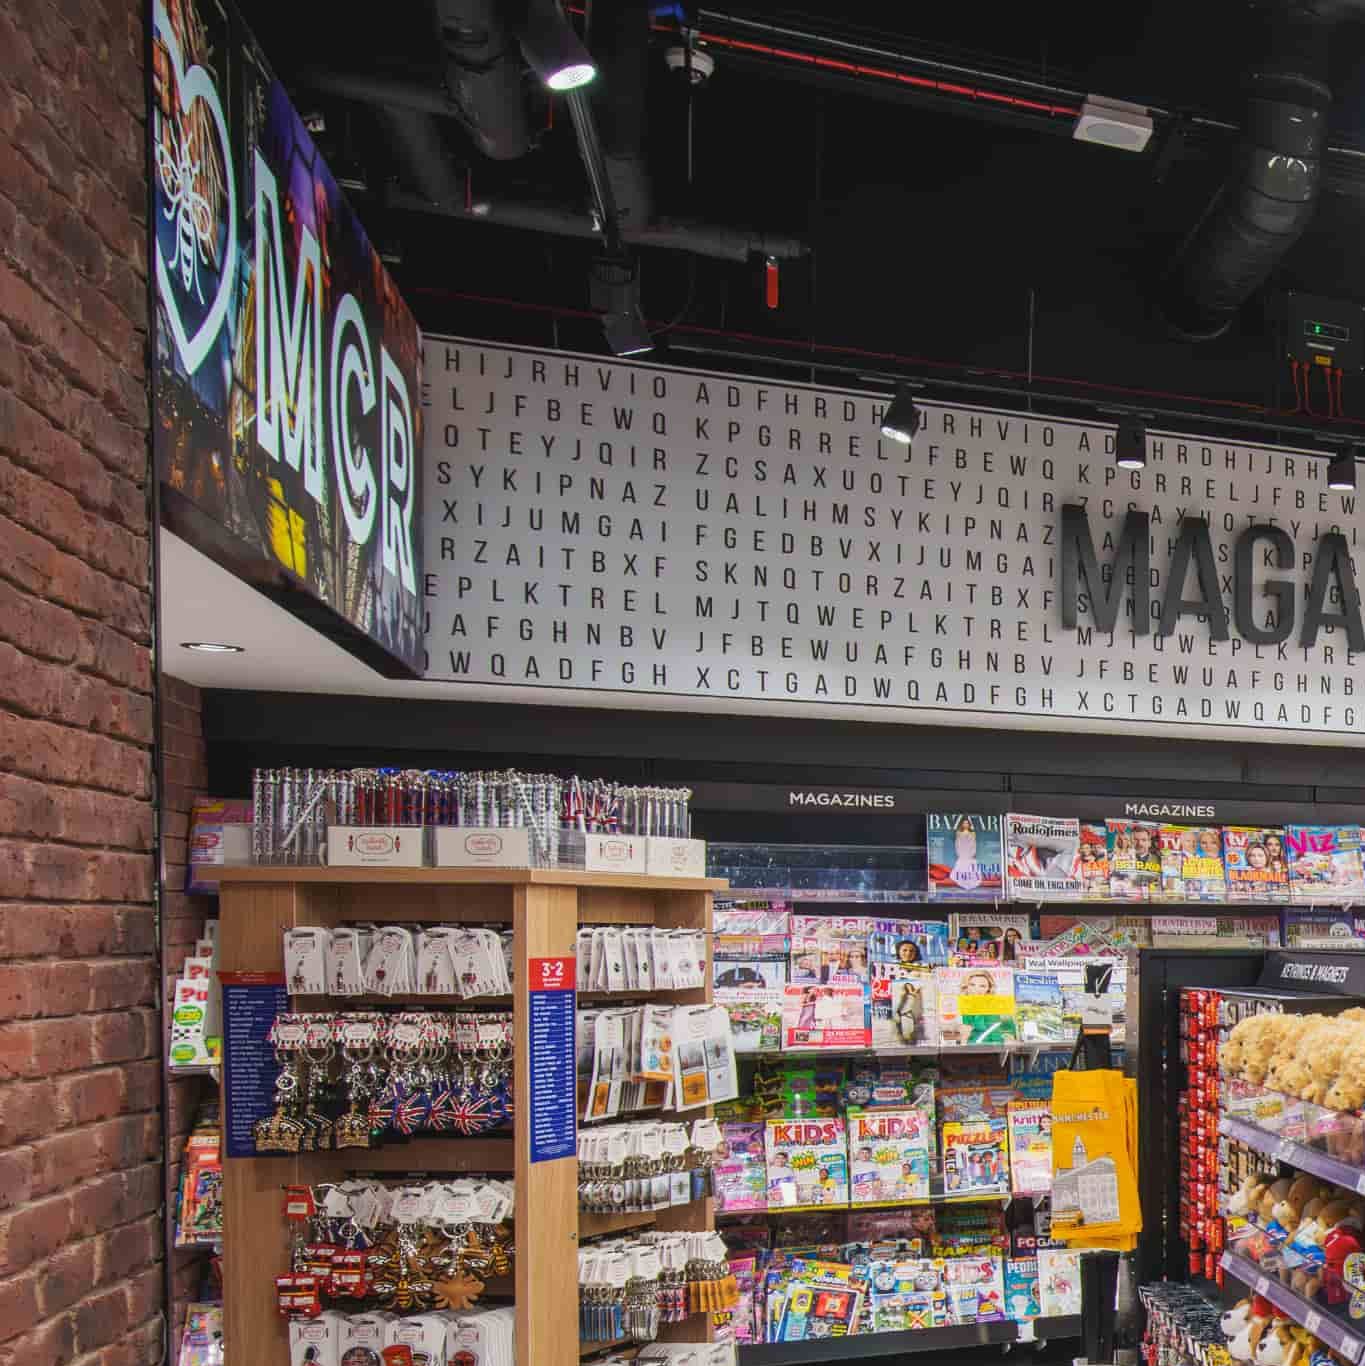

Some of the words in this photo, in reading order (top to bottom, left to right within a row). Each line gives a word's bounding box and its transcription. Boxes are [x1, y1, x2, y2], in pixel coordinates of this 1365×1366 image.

[254, 146, 418, 594] MCR
[789, 791, 895, 808] MAGAZINES
[1125, 803, 1215, 817] MAGAZINES
[929, 813, 998, 831] BAZAR
